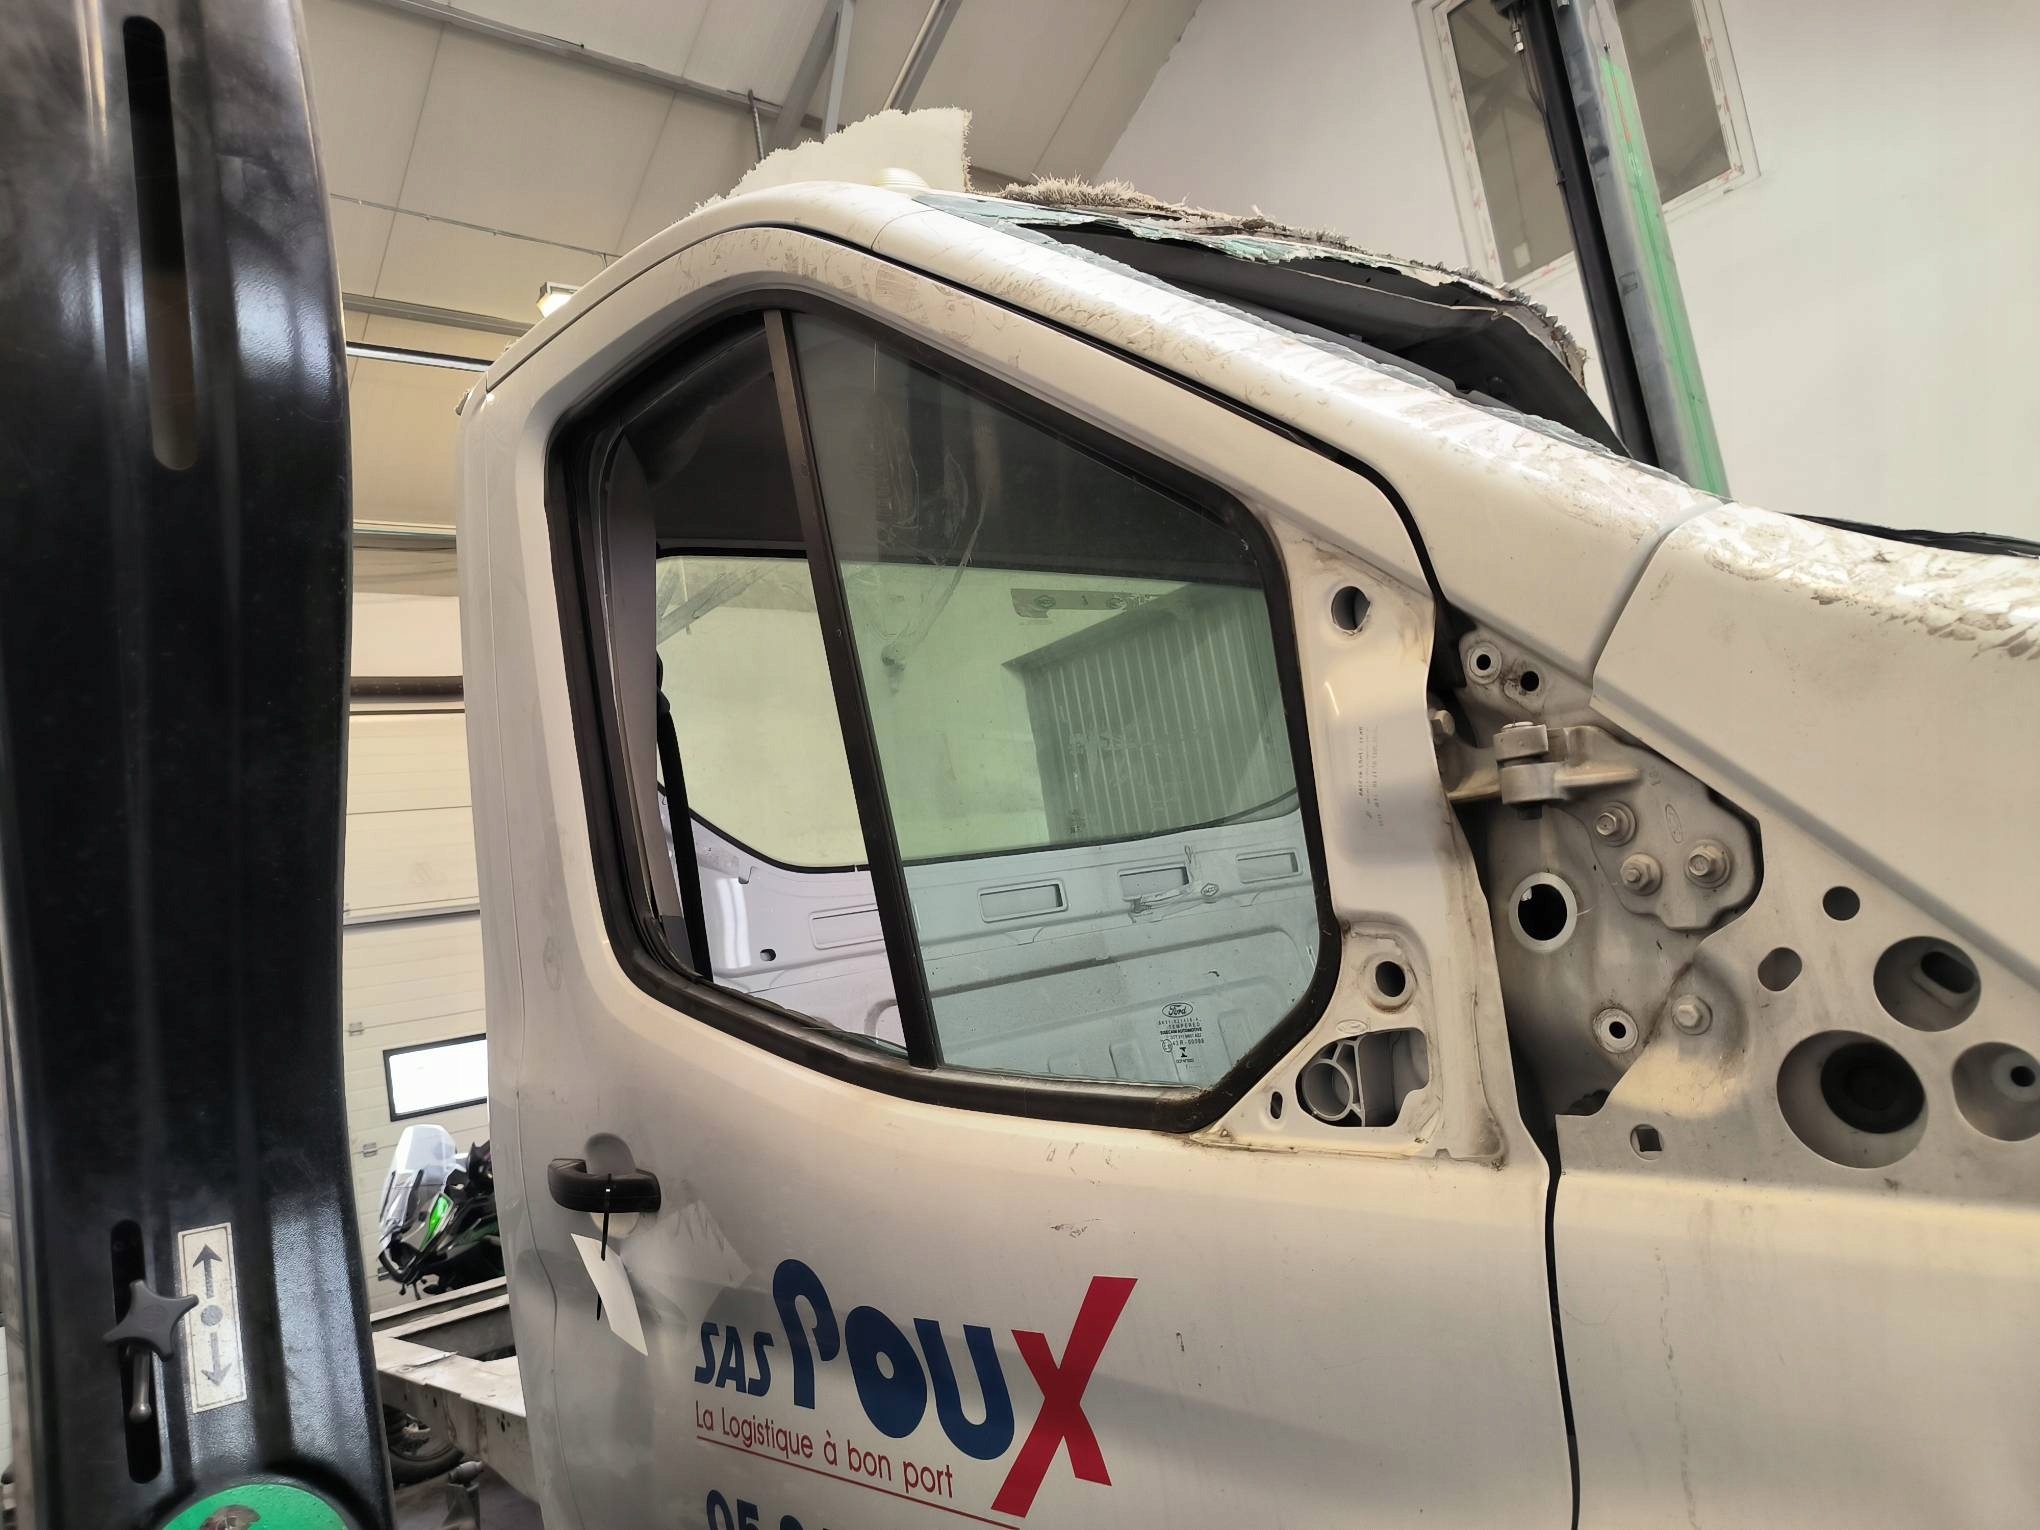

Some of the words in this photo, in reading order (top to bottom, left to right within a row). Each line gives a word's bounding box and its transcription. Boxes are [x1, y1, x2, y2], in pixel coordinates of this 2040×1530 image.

[694, 1322, 774, 1397] SAS
[772, 1258, 1138, 1518] POUX
[695, 1400, 714, 1432] La
[721, 1406, 813, 1459] Logistique
[823, 1429, 838, 1466] à
[847, 1439, 892, 1481] bon
[902, 1460, 953, 1498] port
